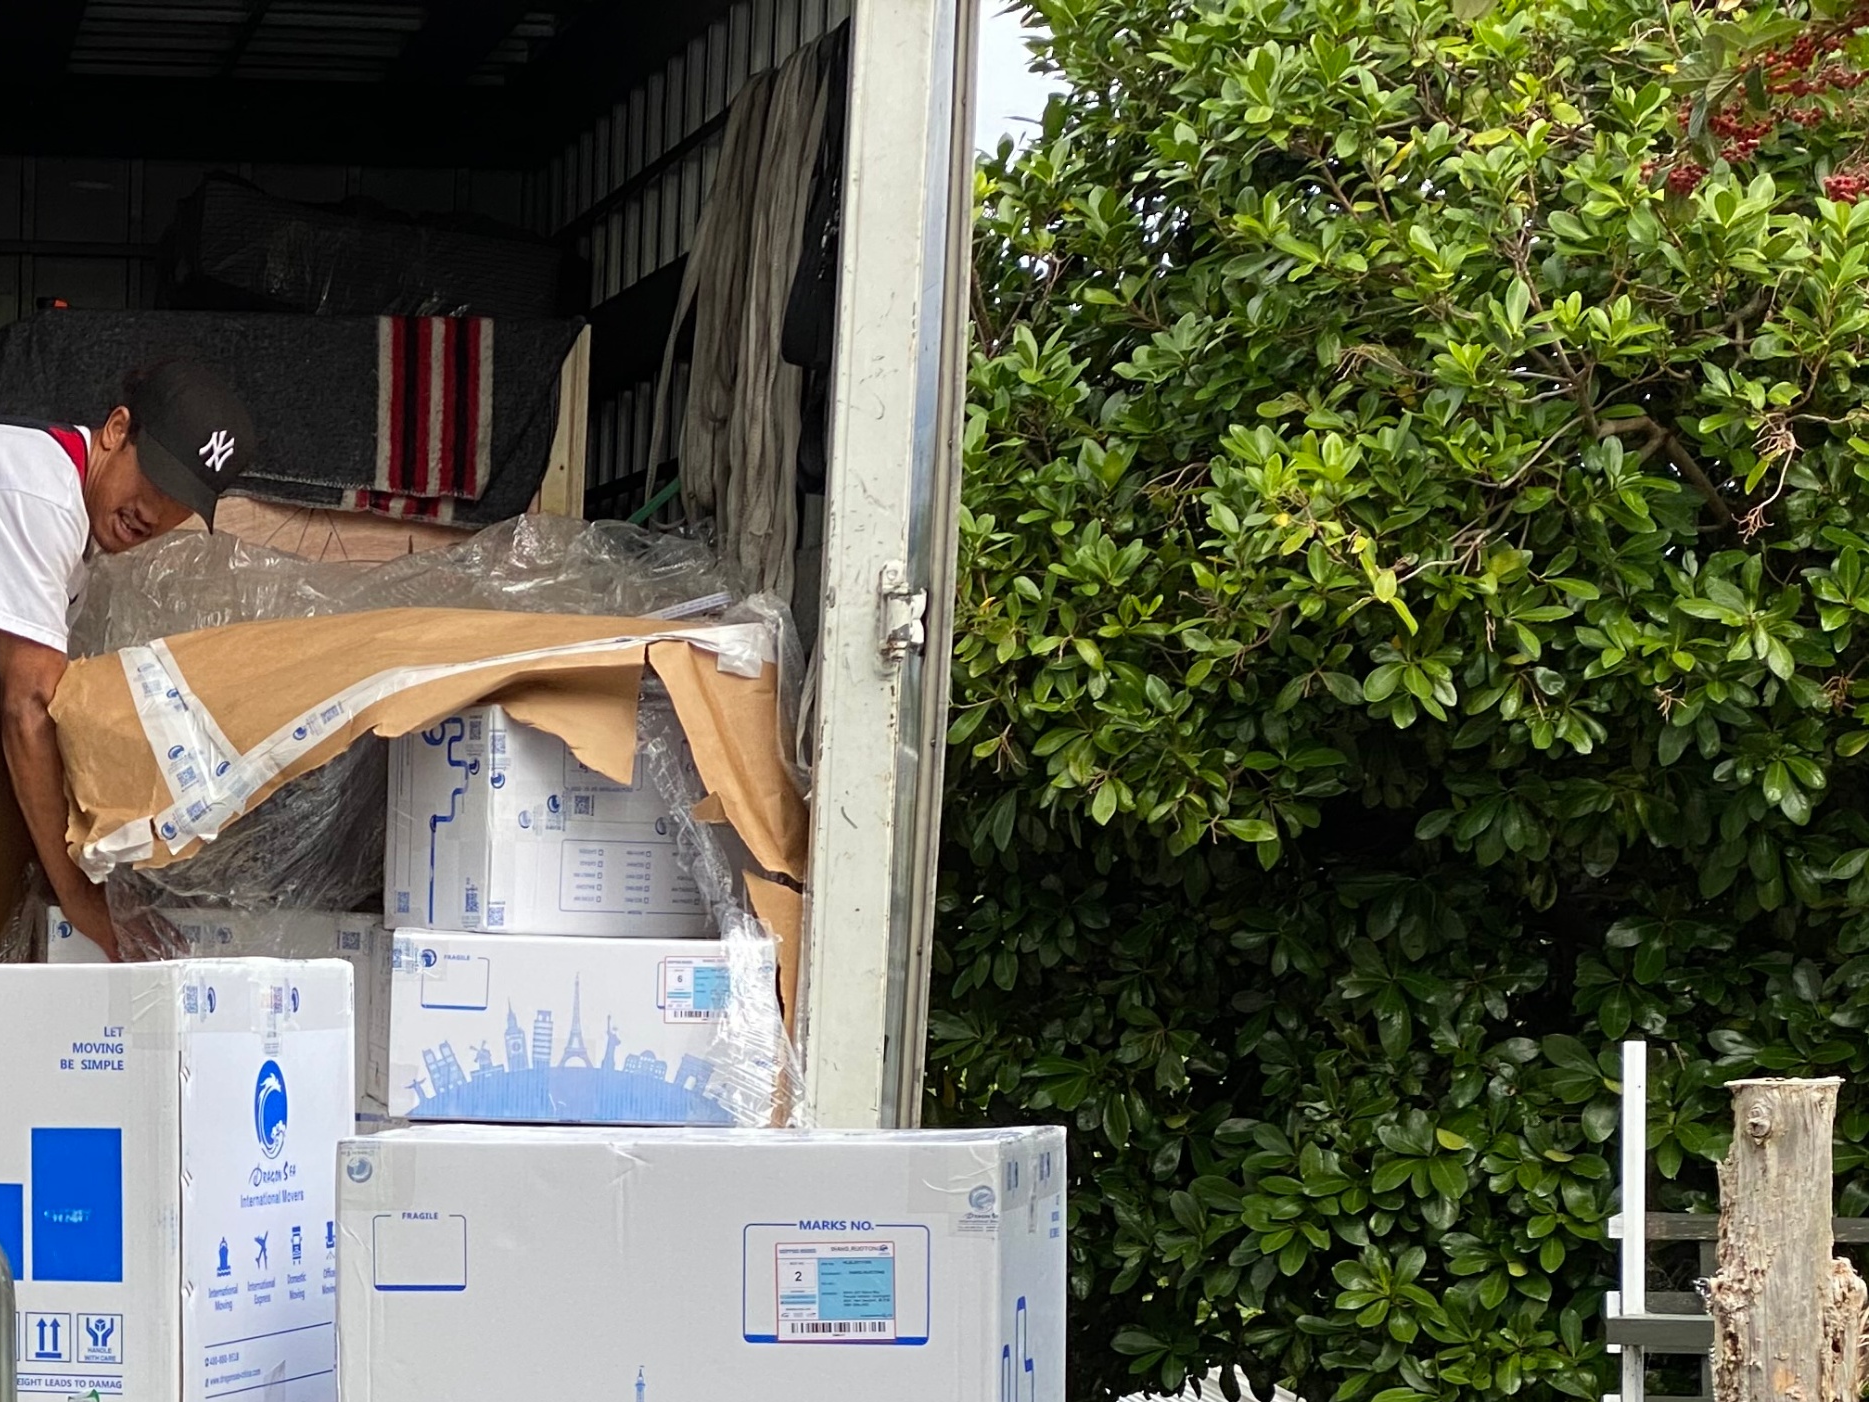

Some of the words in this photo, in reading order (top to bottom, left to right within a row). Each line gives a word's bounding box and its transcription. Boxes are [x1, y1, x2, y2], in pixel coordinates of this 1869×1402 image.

[198, 429, 235, 472] NY
[103, 1026, 124, 1037] LET
[72, 1042, 124, 1054] MOVING
[59, 1058, 75, 1070] BE
[81, 1059, 124, 1071] SIMPLE
[240, 1191, 281, 1208] International
[282, 1189, 304, 1203] Movers
[402, 1212, 439, 1220] FRAGILE
[798, 1219, 847, 1231] MARKS
[850, 1220, 874, 1231] NO.
[794, 1271, 802, 1282] 2
[215, 1300, 232, 1311] Moving
[16, 1378, 42, 1388] EIGHT
[45, 1379, 72, 1388] LEADS
[74, 1379, 87, 1388] TO
[88, 1380, 122, 1389] DAMAG
